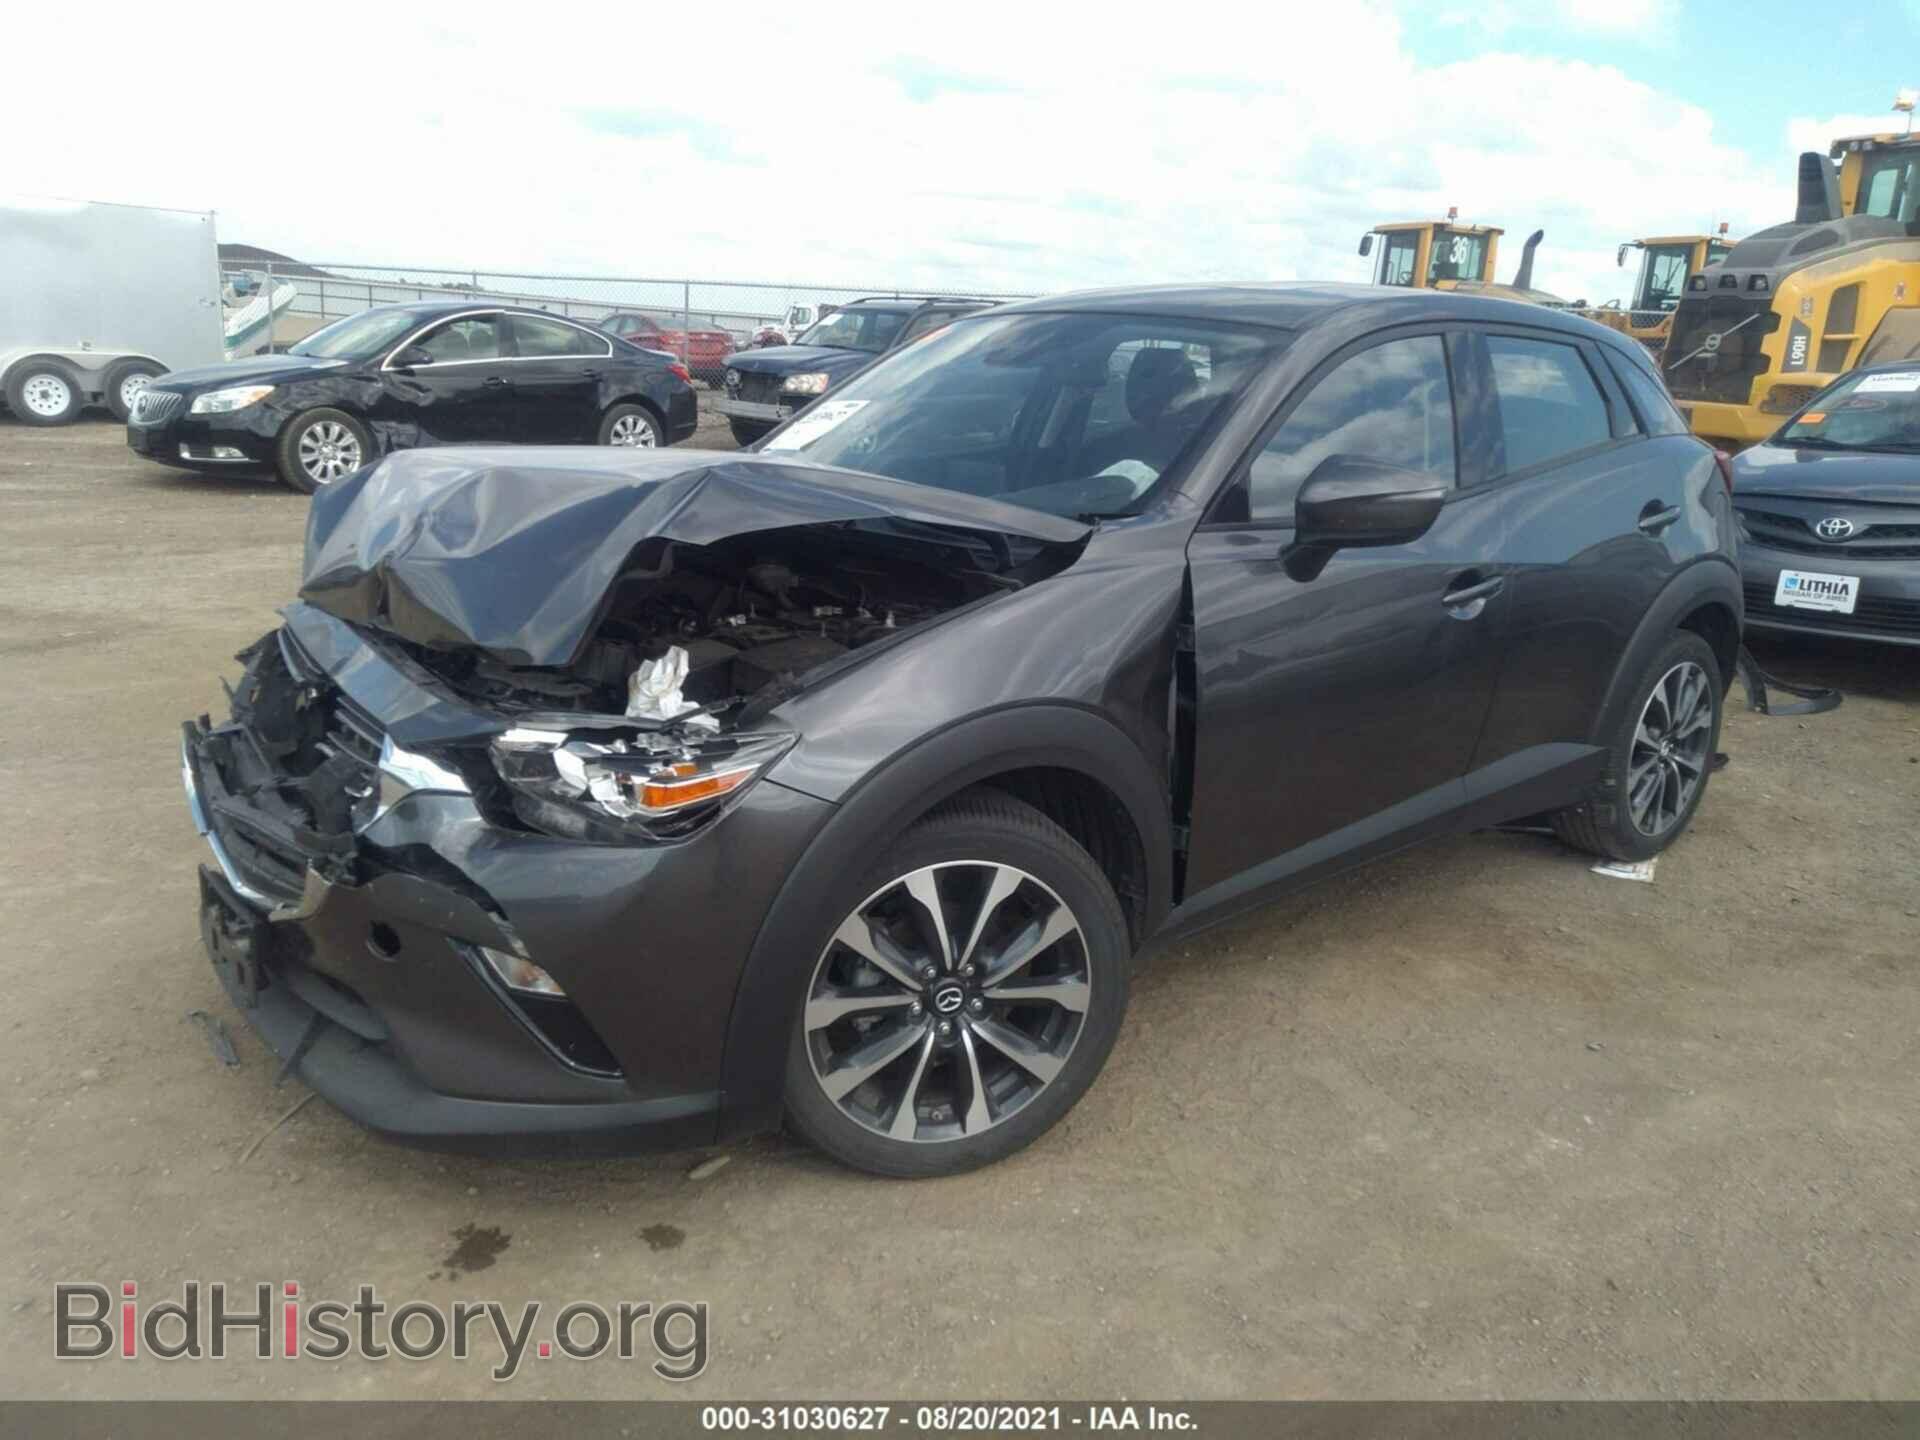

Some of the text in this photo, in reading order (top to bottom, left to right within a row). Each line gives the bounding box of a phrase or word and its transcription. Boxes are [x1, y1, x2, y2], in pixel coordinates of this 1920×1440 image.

[1450, 235, 1468, 264] 36
[1791, 335, 1807, 365] L90H
[1799, 579, 1849, 595] LITHIA
